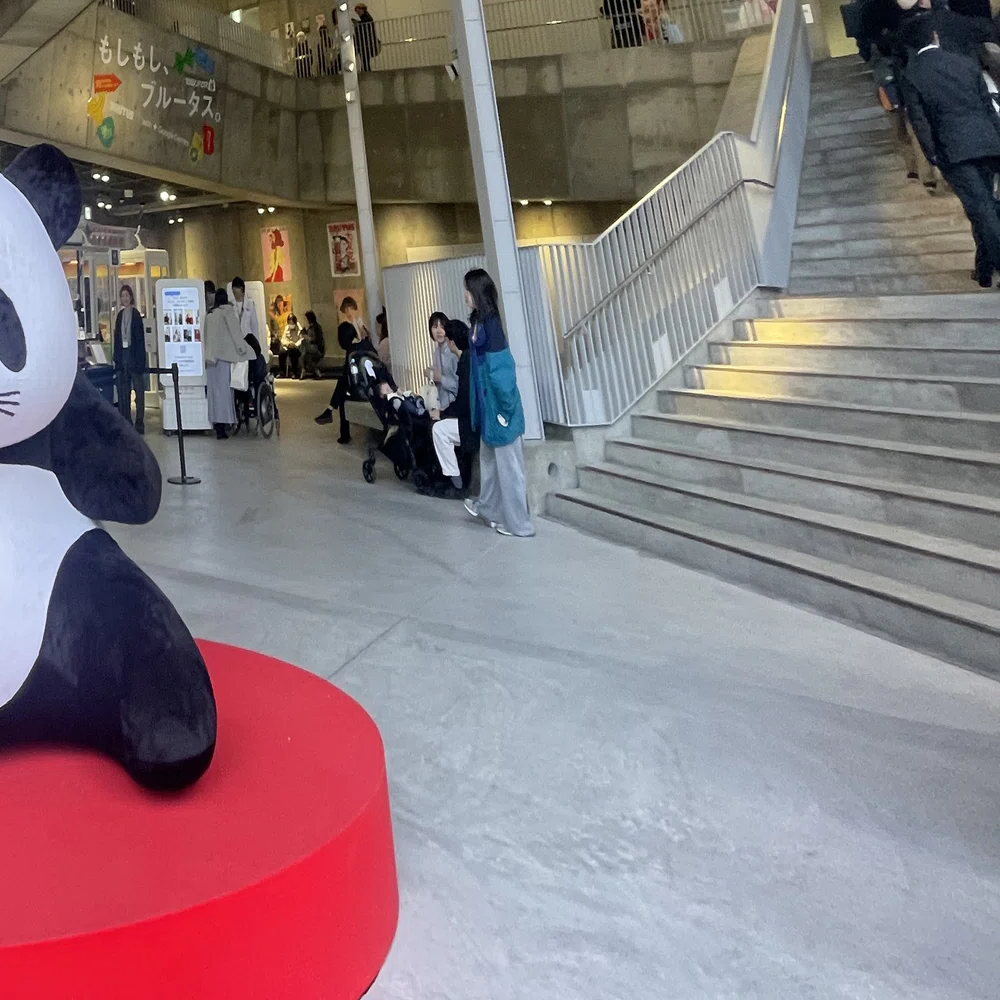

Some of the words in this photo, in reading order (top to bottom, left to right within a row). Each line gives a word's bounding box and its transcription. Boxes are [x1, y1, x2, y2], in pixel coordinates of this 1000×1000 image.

[99, 35, 169, 75] もしもし、
[141, 80, 221, 123] ブルータス。
